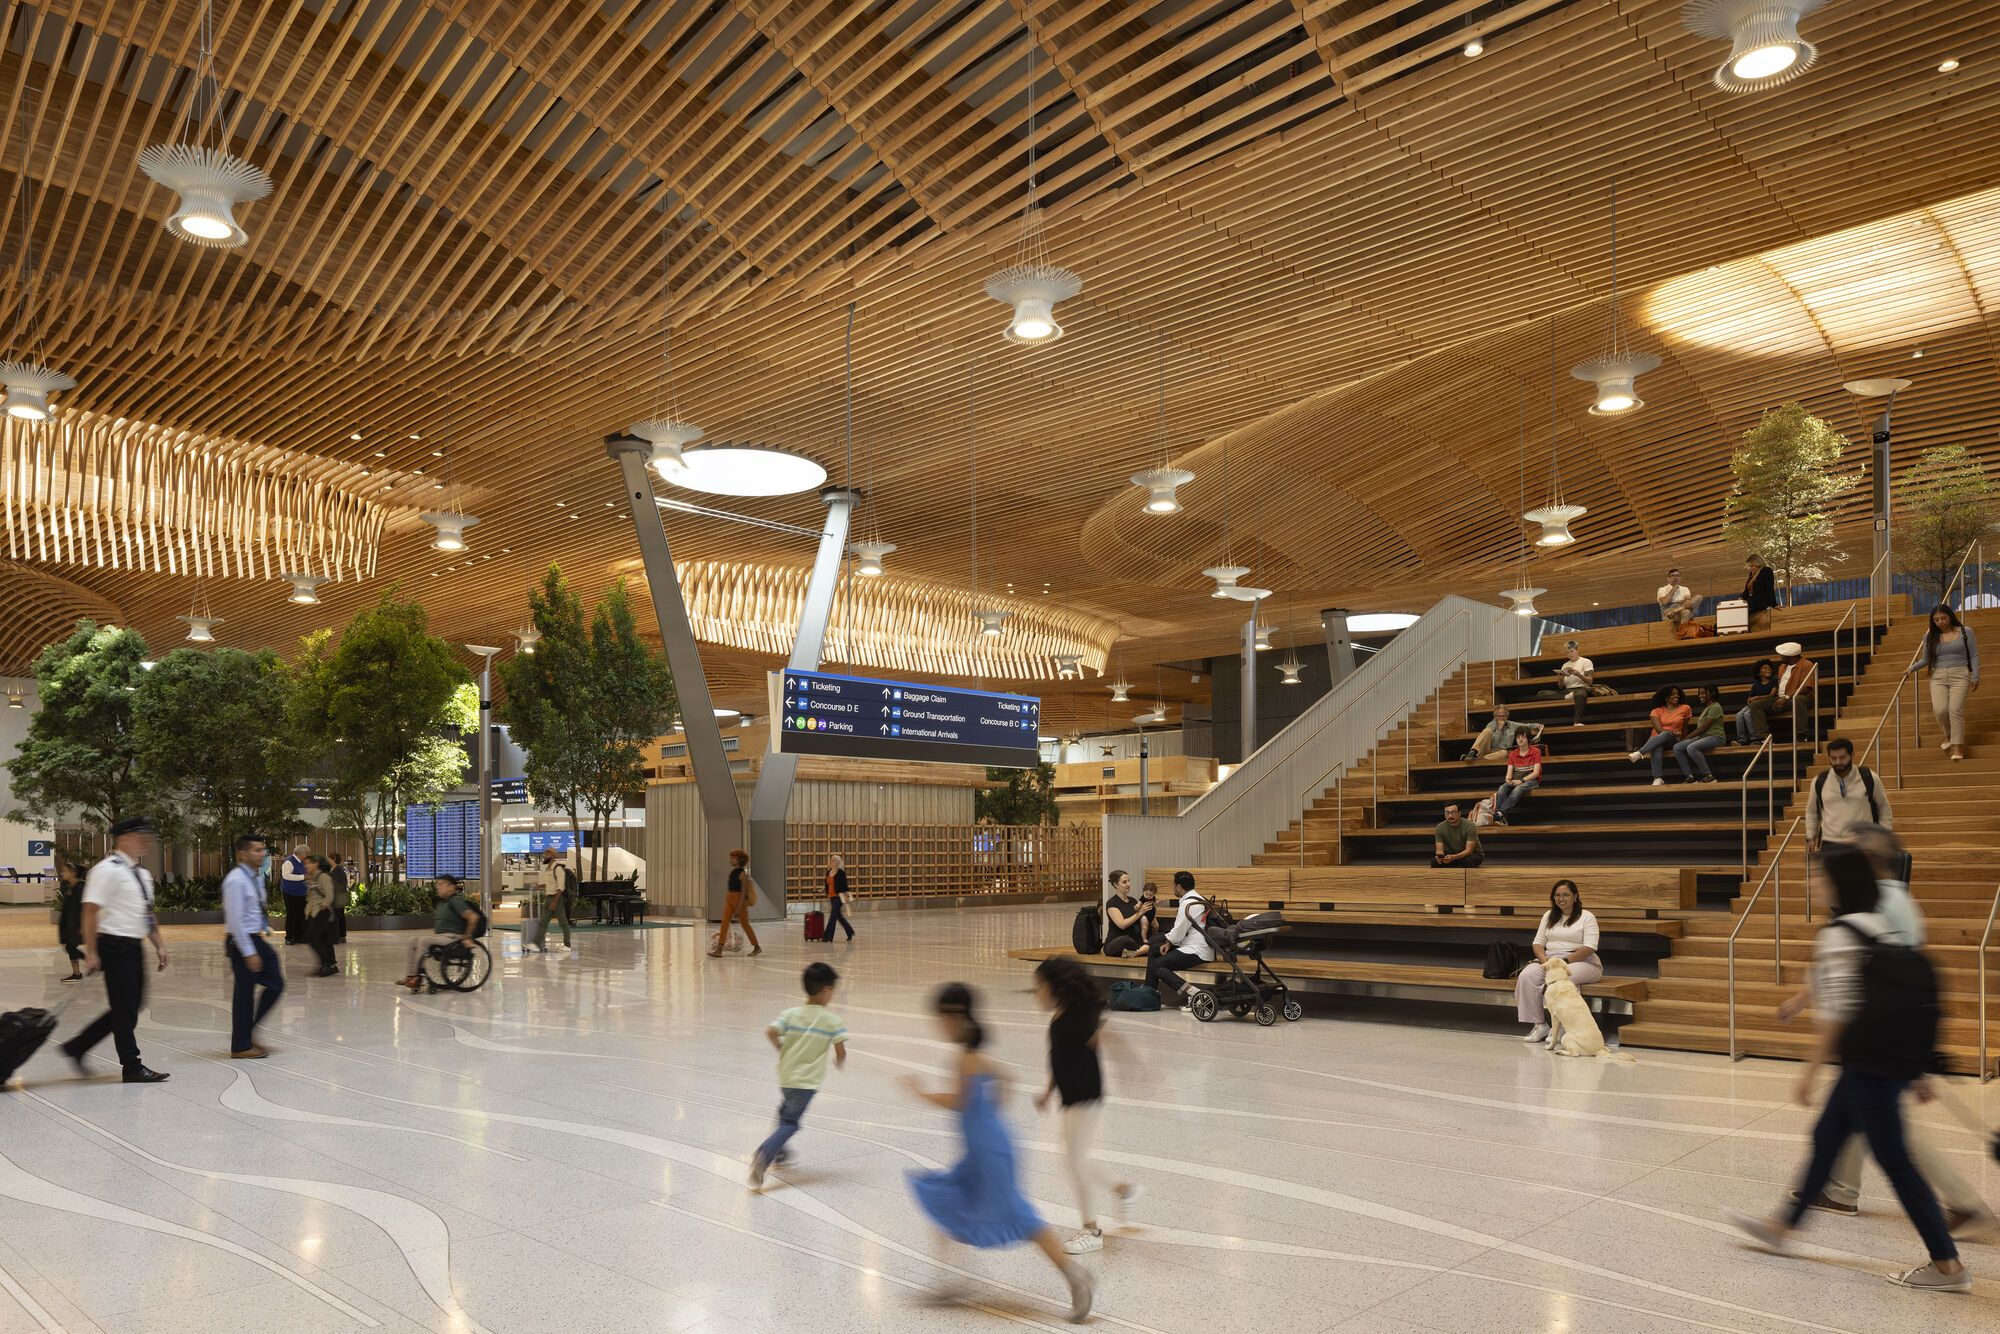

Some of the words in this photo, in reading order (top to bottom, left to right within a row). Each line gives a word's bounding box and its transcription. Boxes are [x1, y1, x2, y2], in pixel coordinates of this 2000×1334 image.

[812, 682, 840, 693] Ticketing
[904, 692, 929, 702] Baggage
[931, 695, 947, 703] Claim
[810, 701, 845, 711] Concourse
[847, 704, 852, 712] D
[997, 702, 1020, 712] Ticketing
[903, 710, 925, 718] Ground
[926, 712, 965, 722] Transportation
[980, 717, 1008, 726] Concourse
[829, 722, 853, 732] Parking
[902, 728, 936, 737] International
[938, 730, 958, 739] Arrivals
[35, 842, 44, 854] 2
